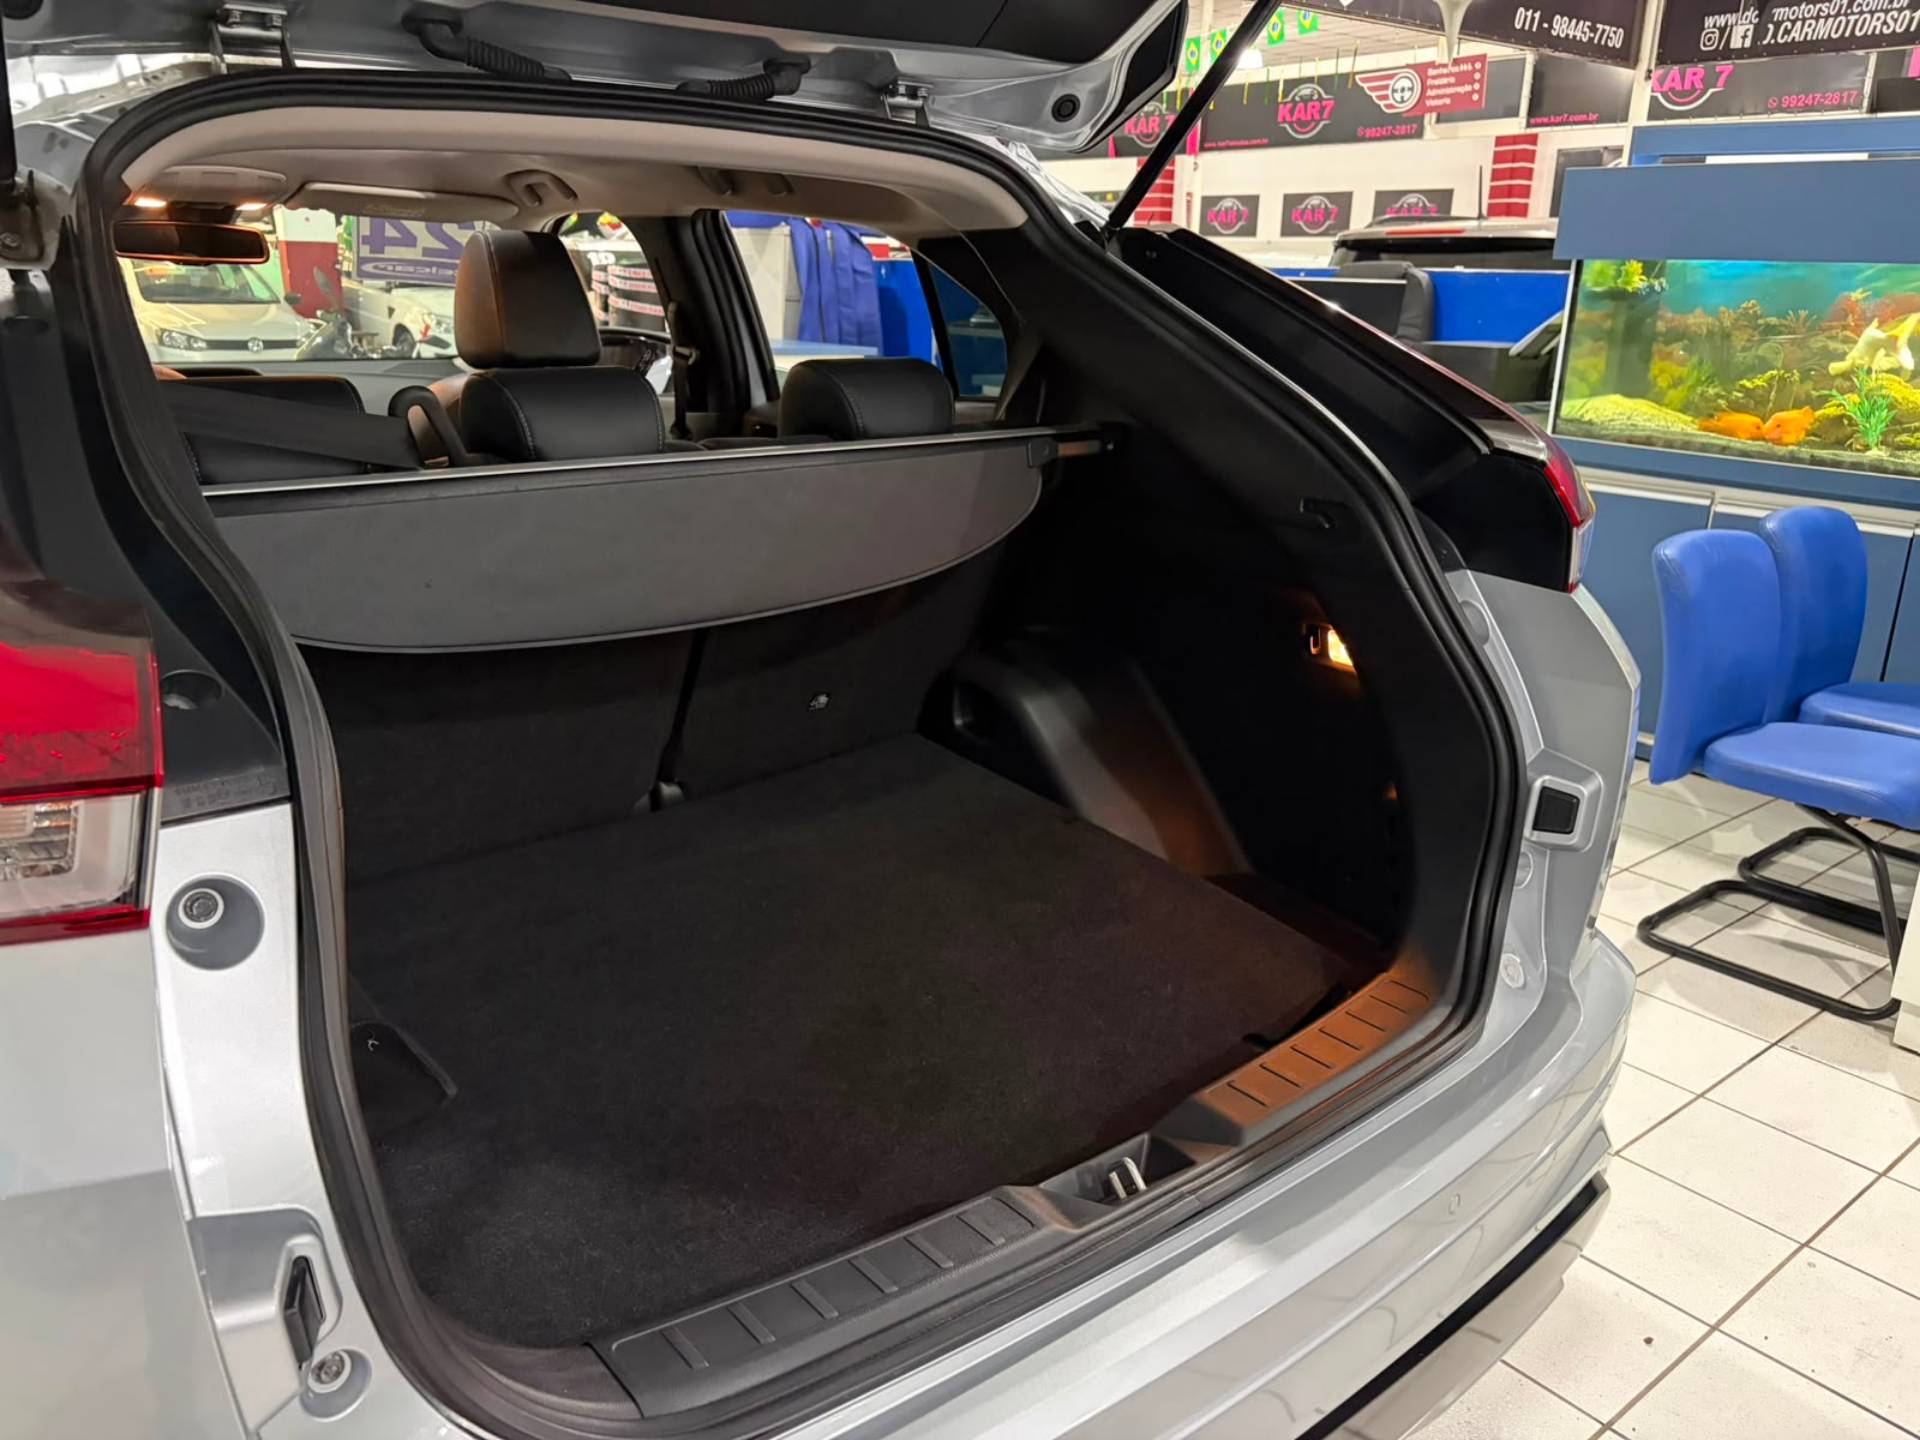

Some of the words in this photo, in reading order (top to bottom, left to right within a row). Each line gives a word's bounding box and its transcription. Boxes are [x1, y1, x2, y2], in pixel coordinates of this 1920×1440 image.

[1514, 7, 1541, 32] 011
[1551, 14, 1624, 48] 98445-7750
[1651, 67, 1705, 92] KAR
[1715, 64, 1734, 88] 7
[1781, 90, 1859, 108] 99247-2817
[1124, 115, 1160, 134] KAR
[1530, 112, 1600, 124] www.kar7.com.br
[1207, 208, 1238, 225] KAR
[1291, 208, 1325, 224] KAR
[1329, 207, 1339, 223] 7
